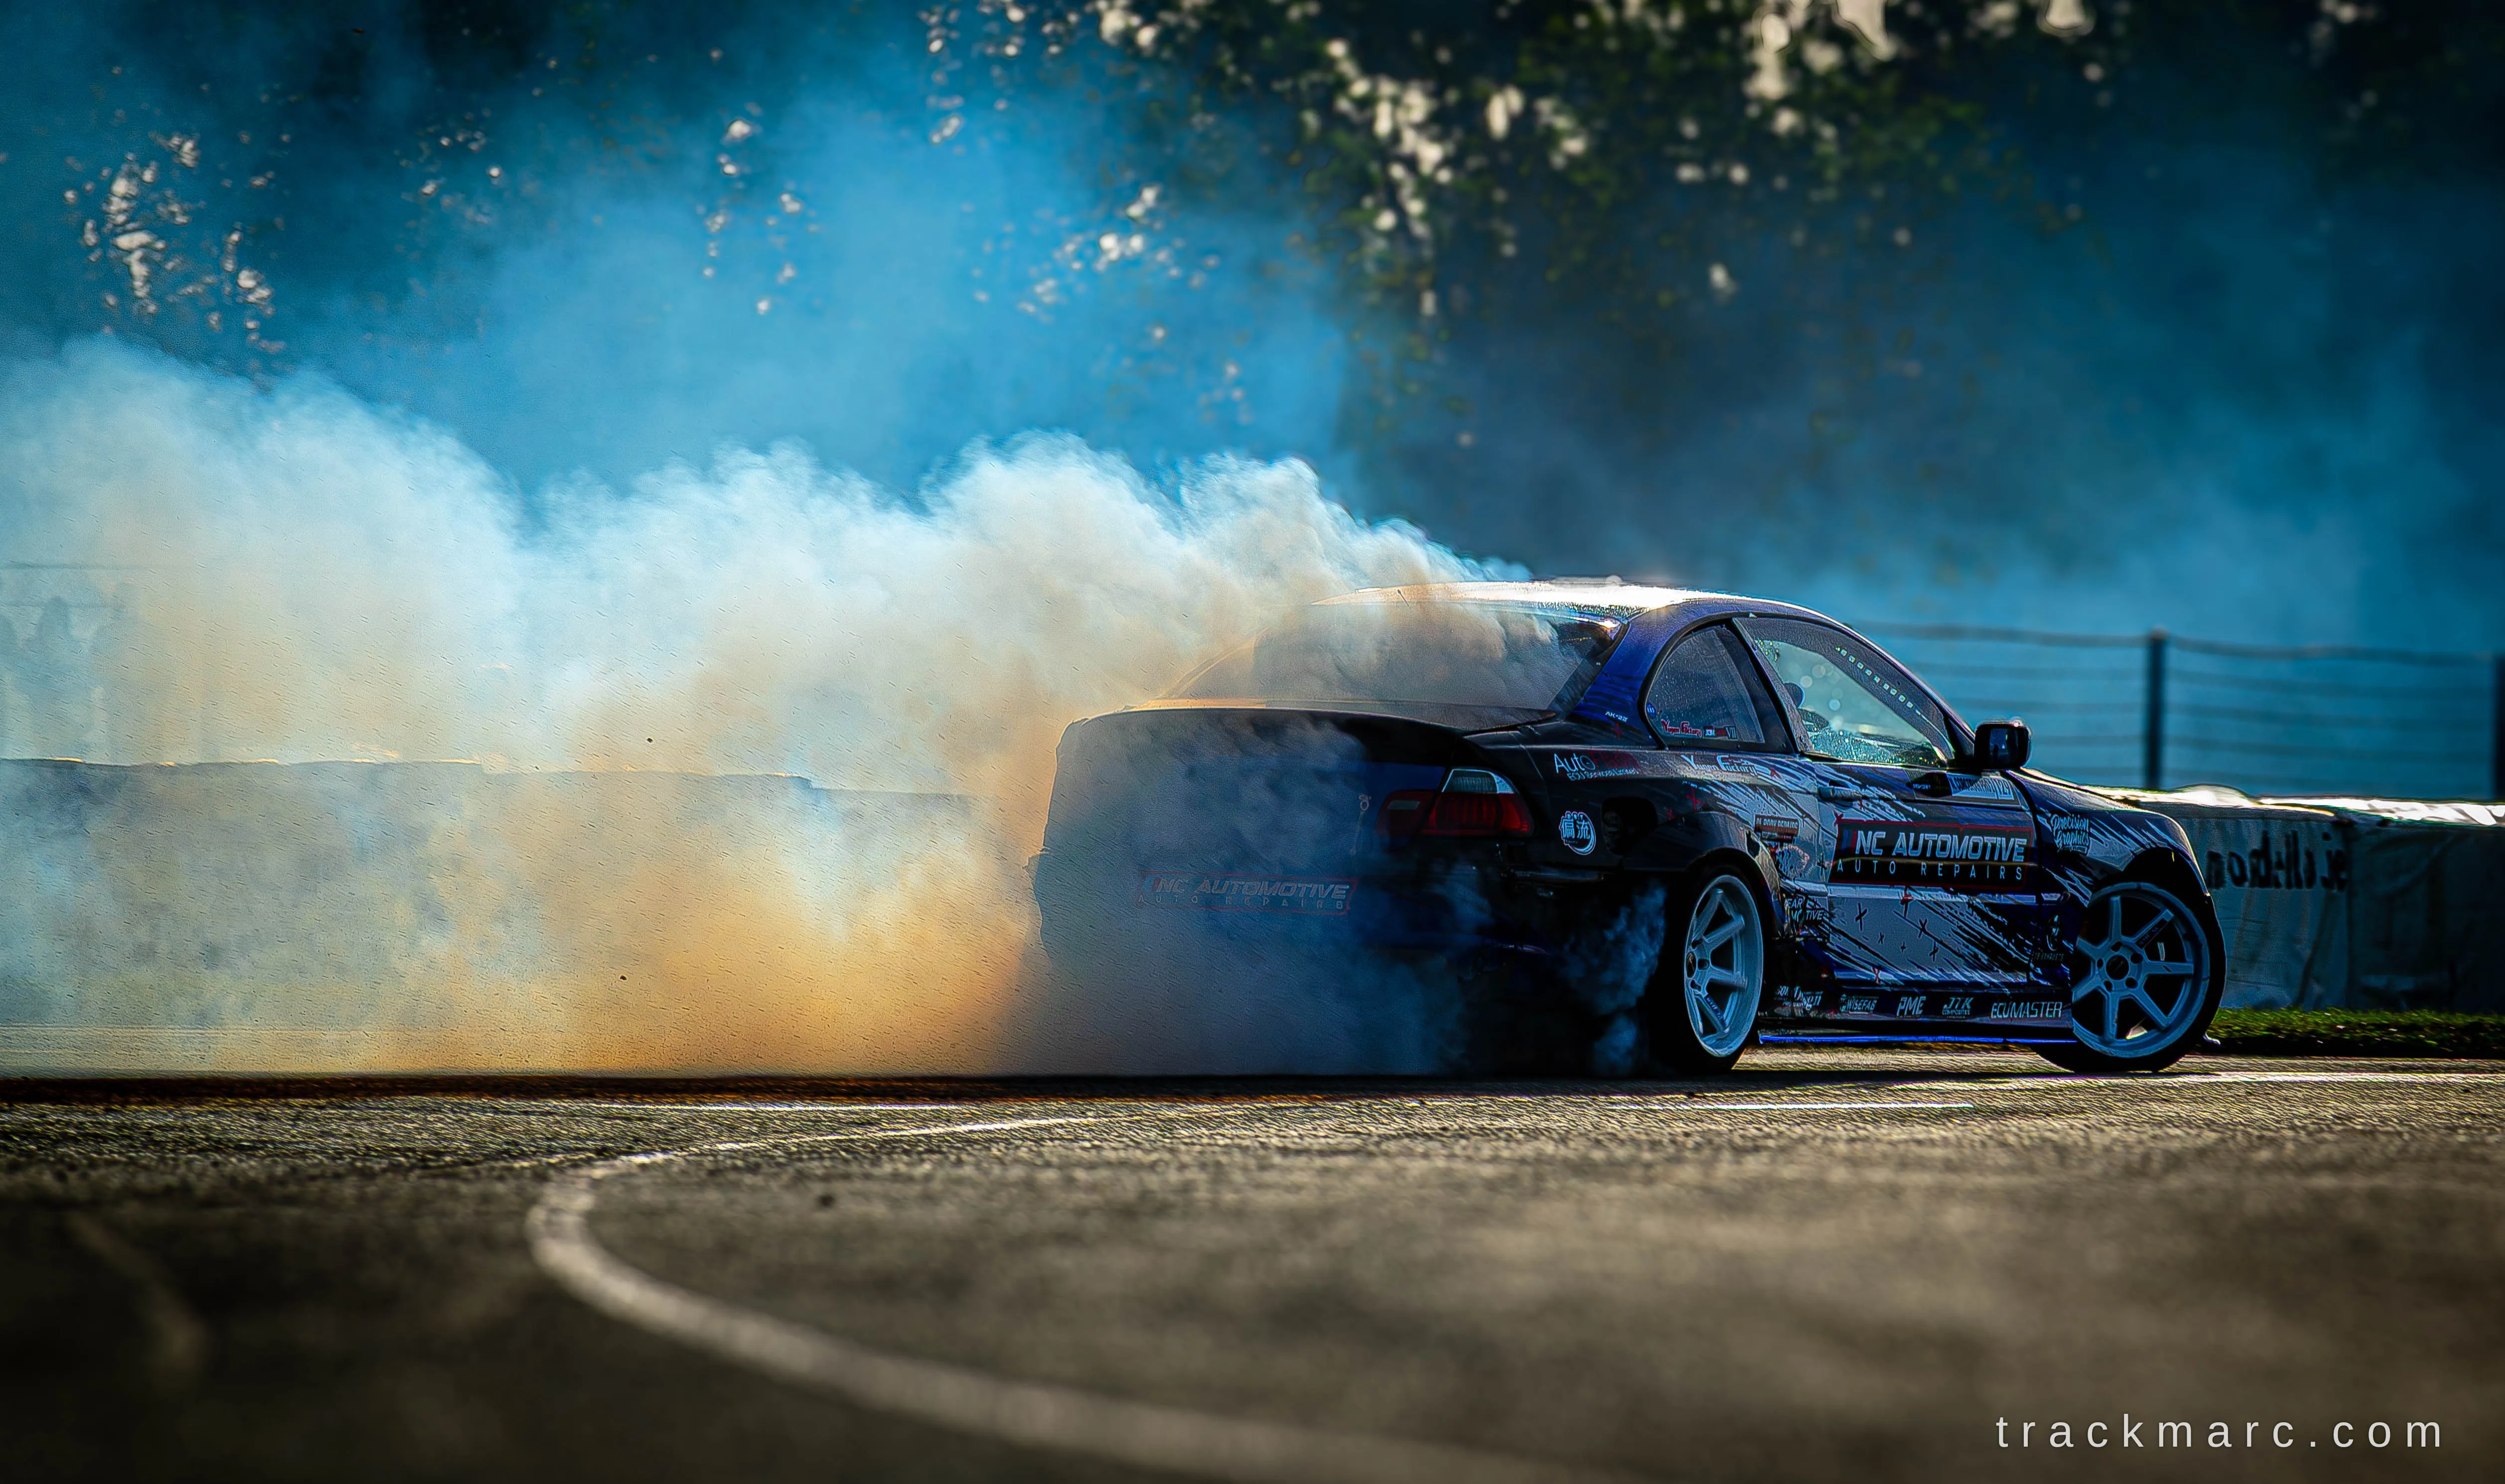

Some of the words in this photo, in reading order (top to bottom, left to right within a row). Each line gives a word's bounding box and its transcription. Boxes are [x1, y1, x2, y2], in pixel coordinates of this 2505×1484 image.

[2050, 813, 2089, 837] Precision
[1854, 830, 1886, 856] NC
[1891, 832, 2027, 863] AUTOMOTIVE
[2053, 830, 2089, 853] Graphics
[1837, 859, 1896, 874] AUTO
[1921, 862, 2022, 880] REPAIRS
[1156, 877, 1189, 892] NC
[1195, 877, 1349, 899] AUTOMOTIVE
[1846, 997, 1878, 1011] WISEFAB
[1896, 995, 1927, 1016] PME
[1990, 1001, 2064, 1019] ECUMASTER
